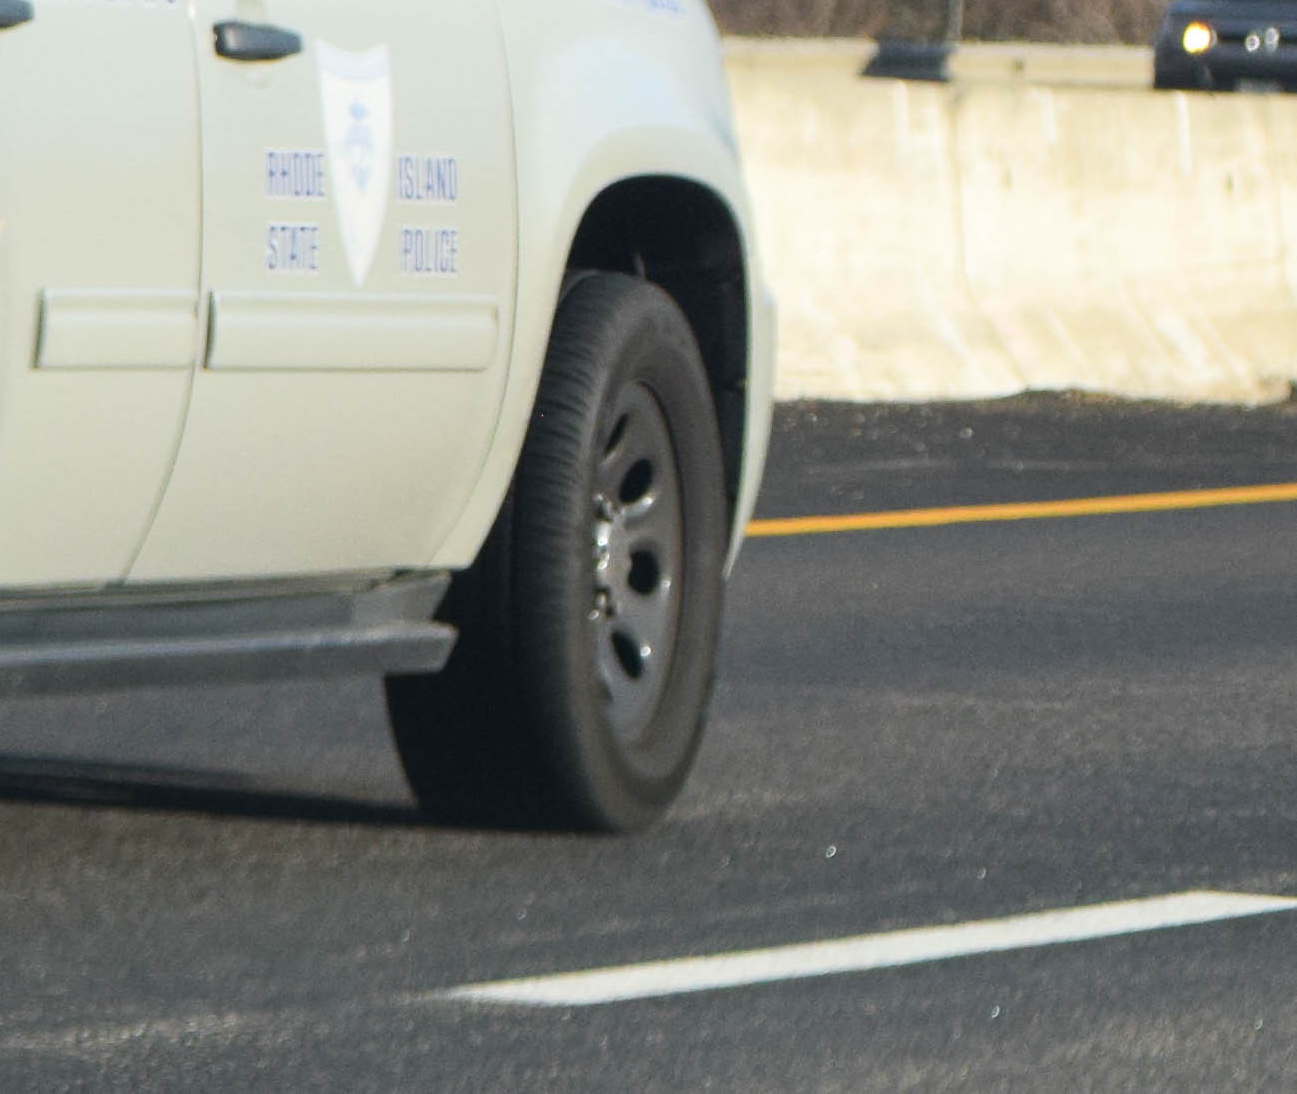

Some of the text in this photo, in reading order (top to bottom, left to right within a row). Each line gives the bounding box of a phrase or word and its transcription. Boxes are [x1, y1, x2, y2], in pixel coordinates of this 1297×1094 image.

[265, 151, 458, 201] RHODE ISLAND
[267, 225, 458, 273] STATE POLICE
